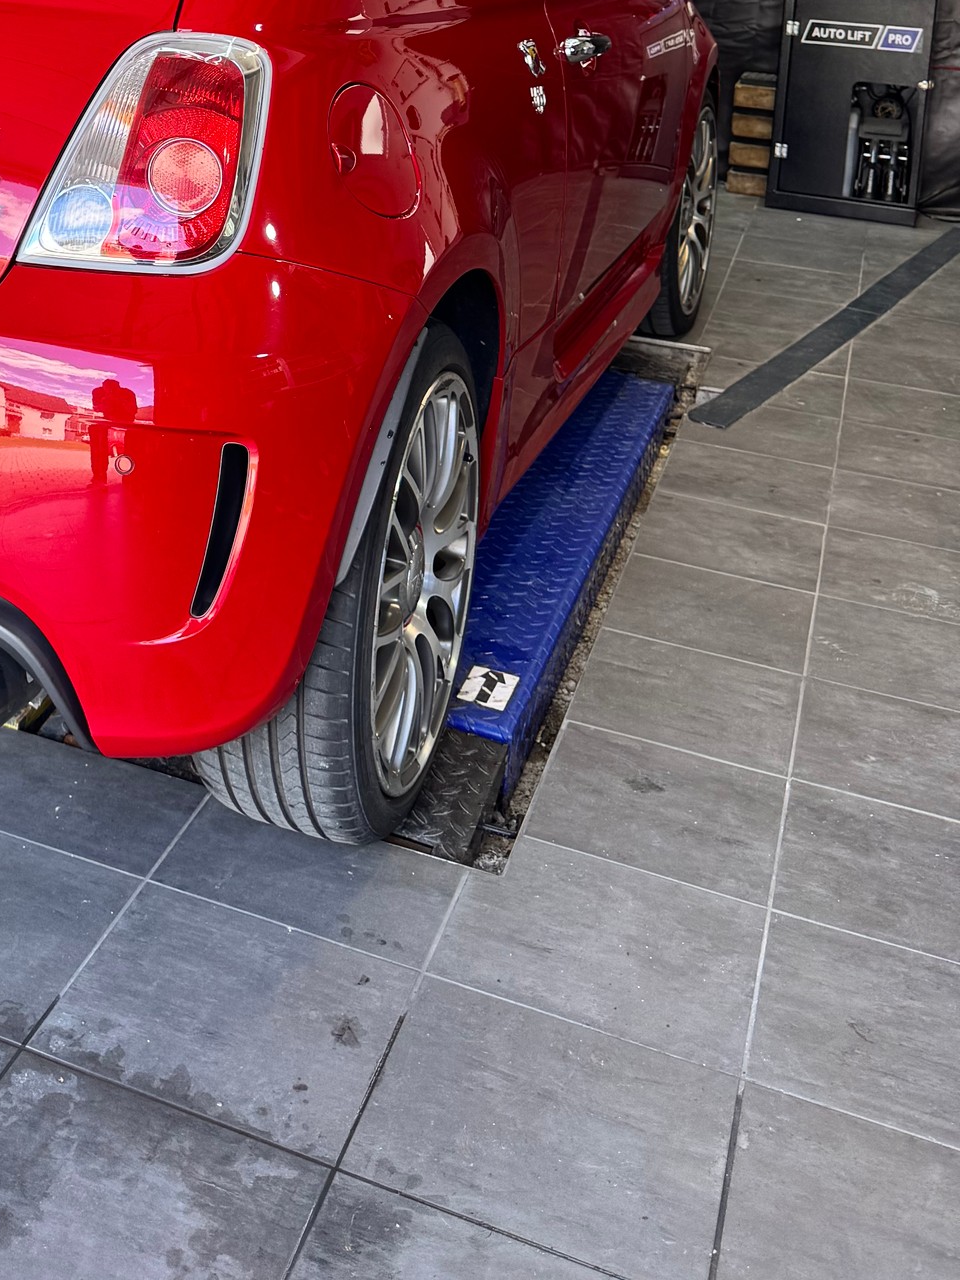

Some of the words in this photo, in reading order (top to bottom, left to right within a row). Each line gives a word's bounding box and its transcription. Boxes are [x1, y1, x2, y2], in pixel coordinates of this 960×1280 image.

[811, 26, 846, 40] AUTO
[847, 28, 872, 42] LIFT
[887, 33, 912, 46] PRO
